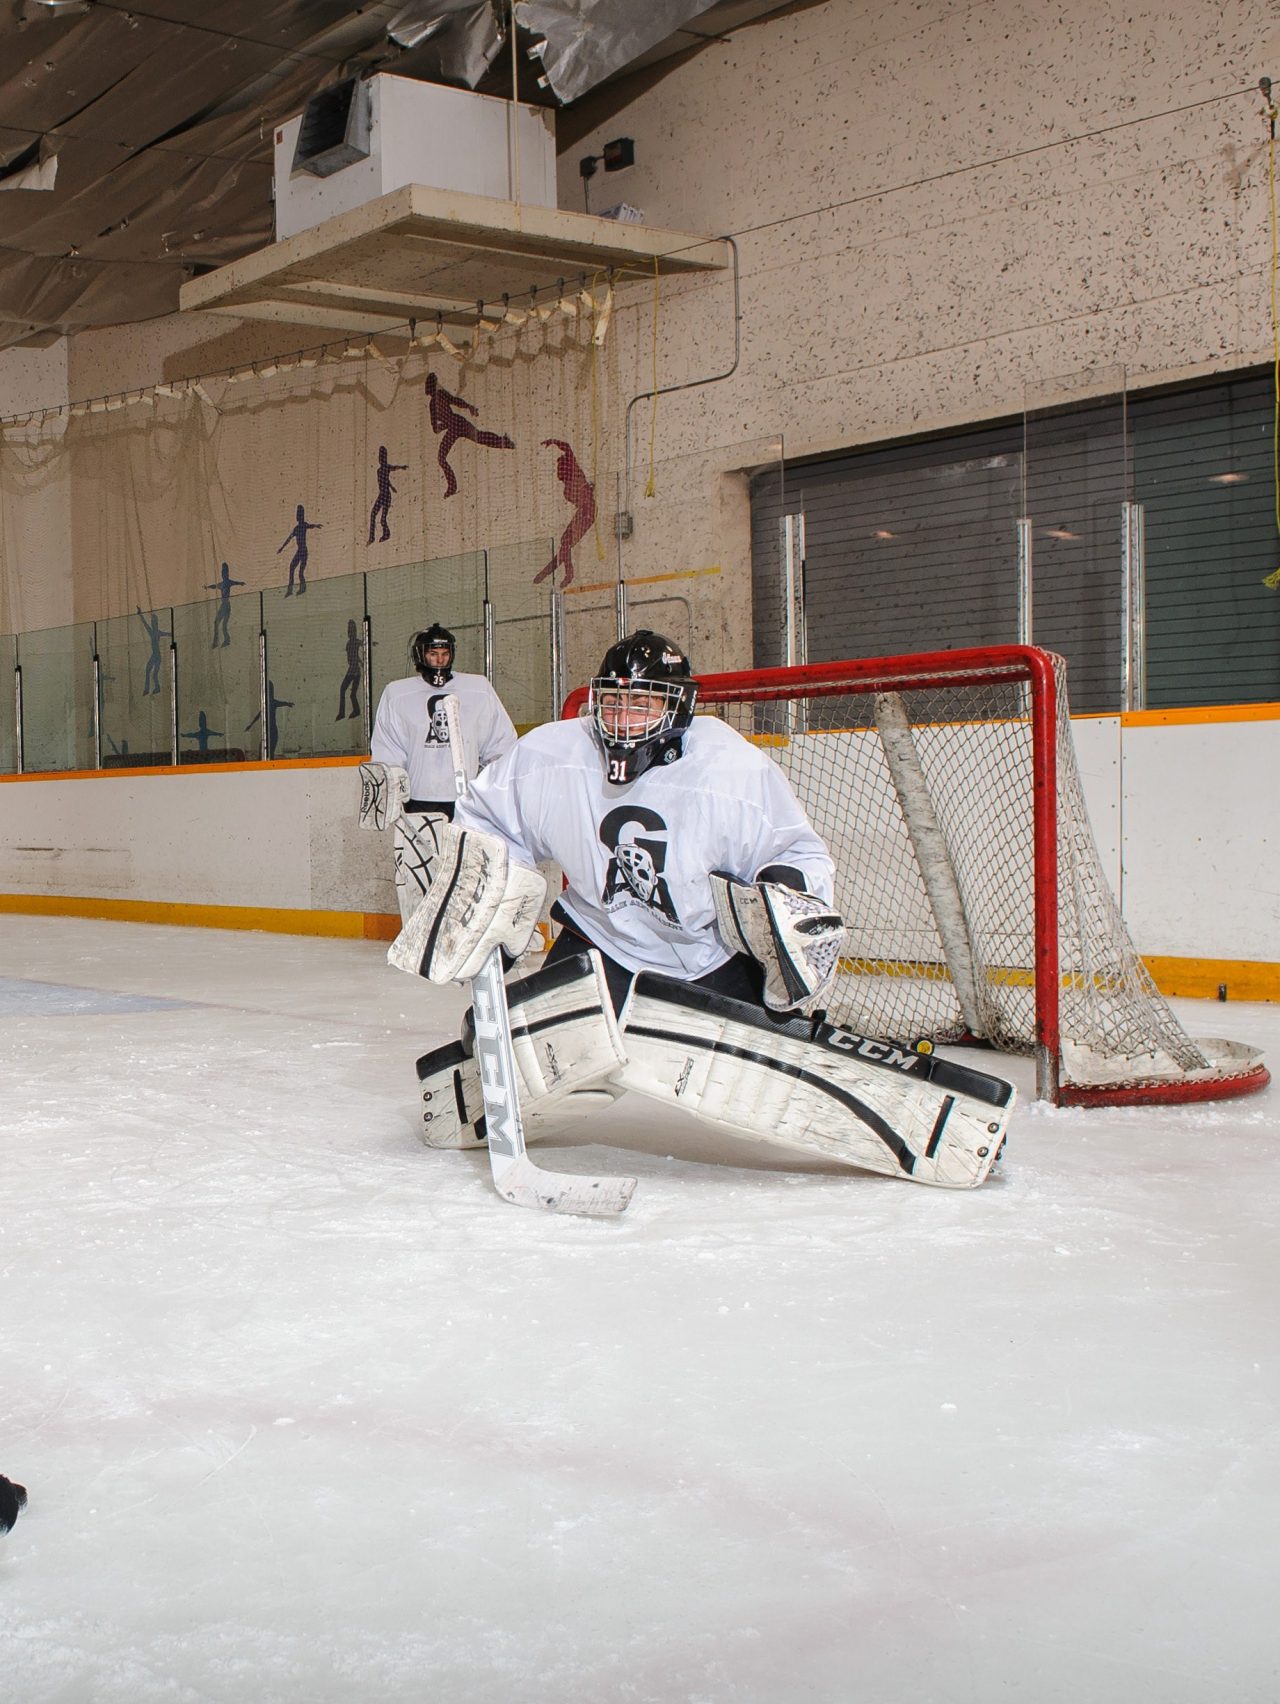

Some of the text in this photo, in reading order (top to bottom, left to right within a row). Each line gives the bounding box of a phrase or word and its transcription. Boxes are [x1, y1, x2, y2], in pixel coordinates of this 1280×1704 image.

[433, 675, 444, 686] 35
[609, 760, 627, 781] 31
[360, 780, 370, 813] Reebok
[827, 1028, 919, 1071] CCM
[472, 975, 516, 1159] CCM
